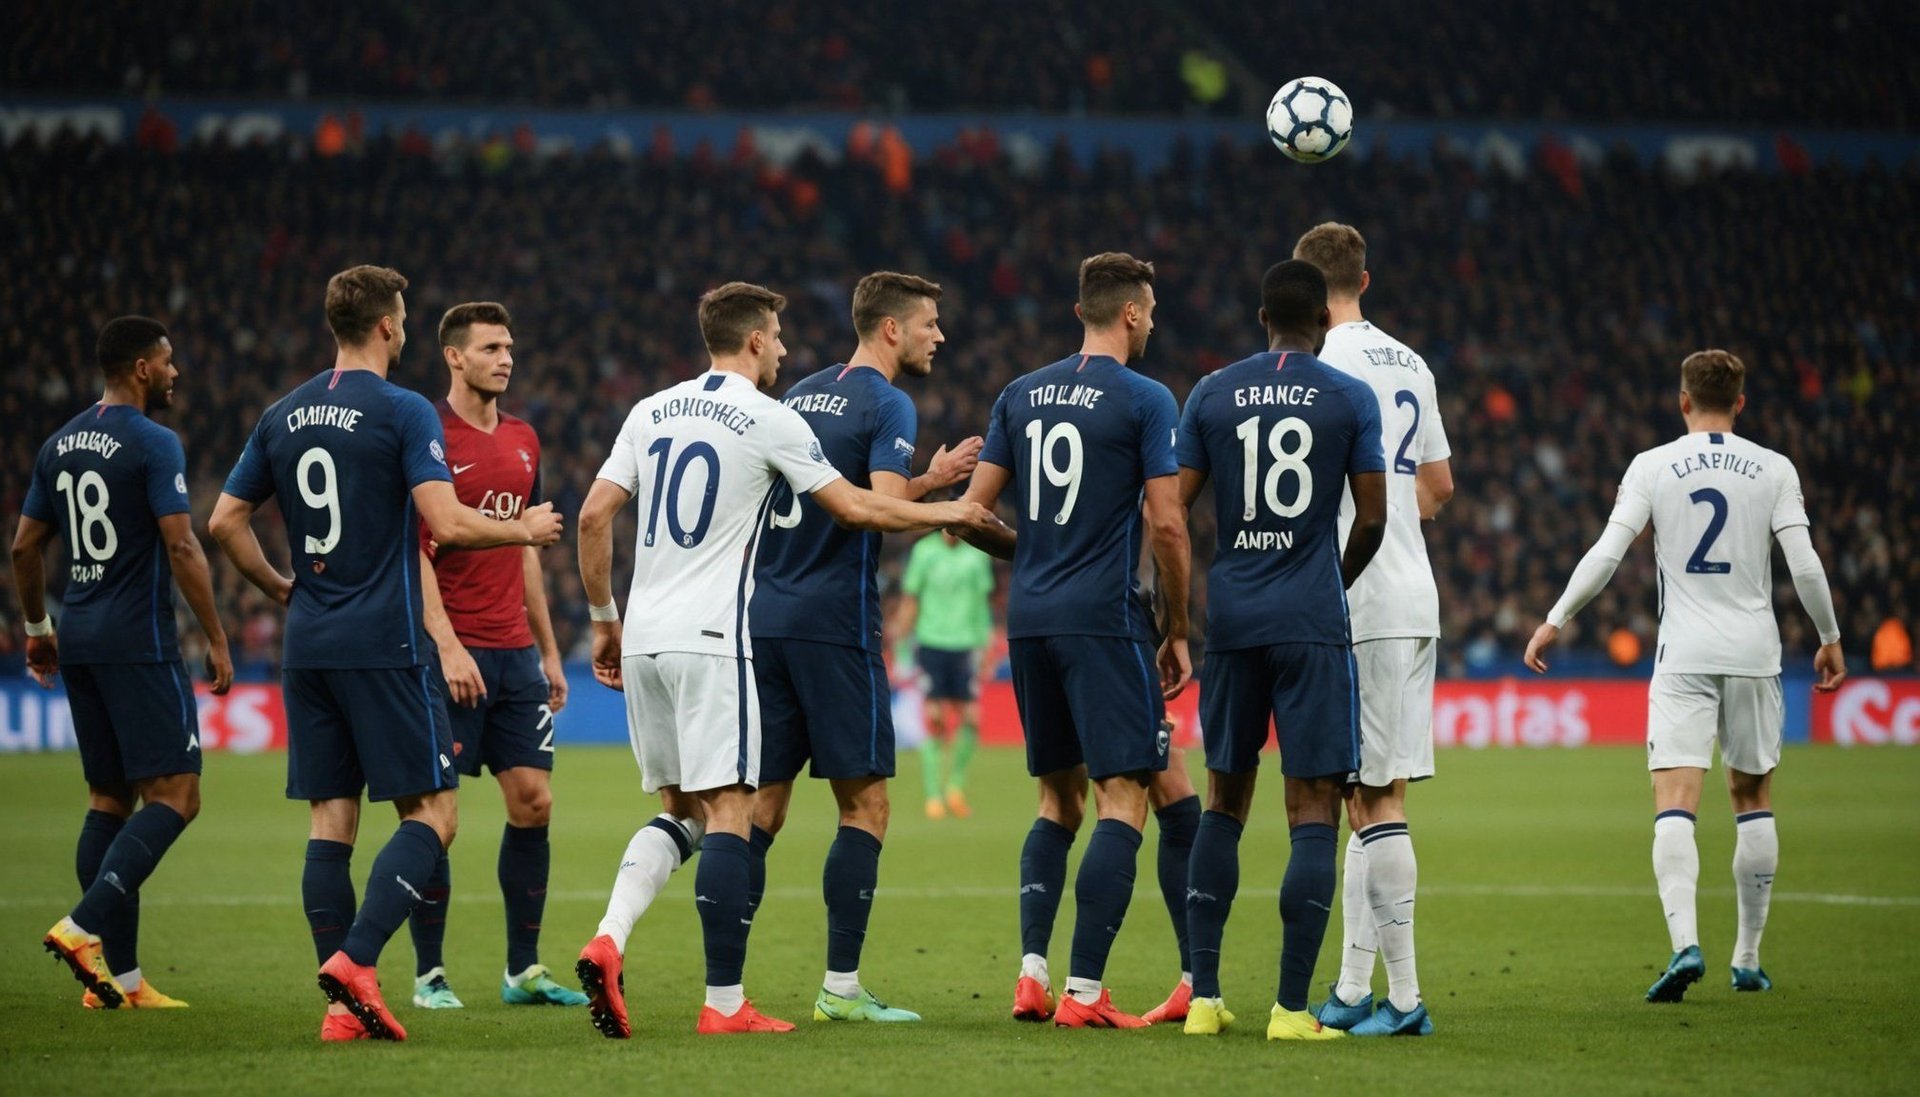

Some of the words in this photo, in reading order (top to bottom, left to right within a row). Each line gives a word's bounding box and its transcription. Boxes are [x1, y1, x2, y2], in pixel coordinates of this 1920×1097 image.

[1025, 419, 1084, 525] 19
[1236, 416, 1313, 522] 18
[1394, 389, 1420, 475] 2
[56, 470, 118, 561] 18
[296, 447, 342, 555] 9
[644, 437, 721, 549] 10
[1686, 488, 1732, 575] 2
